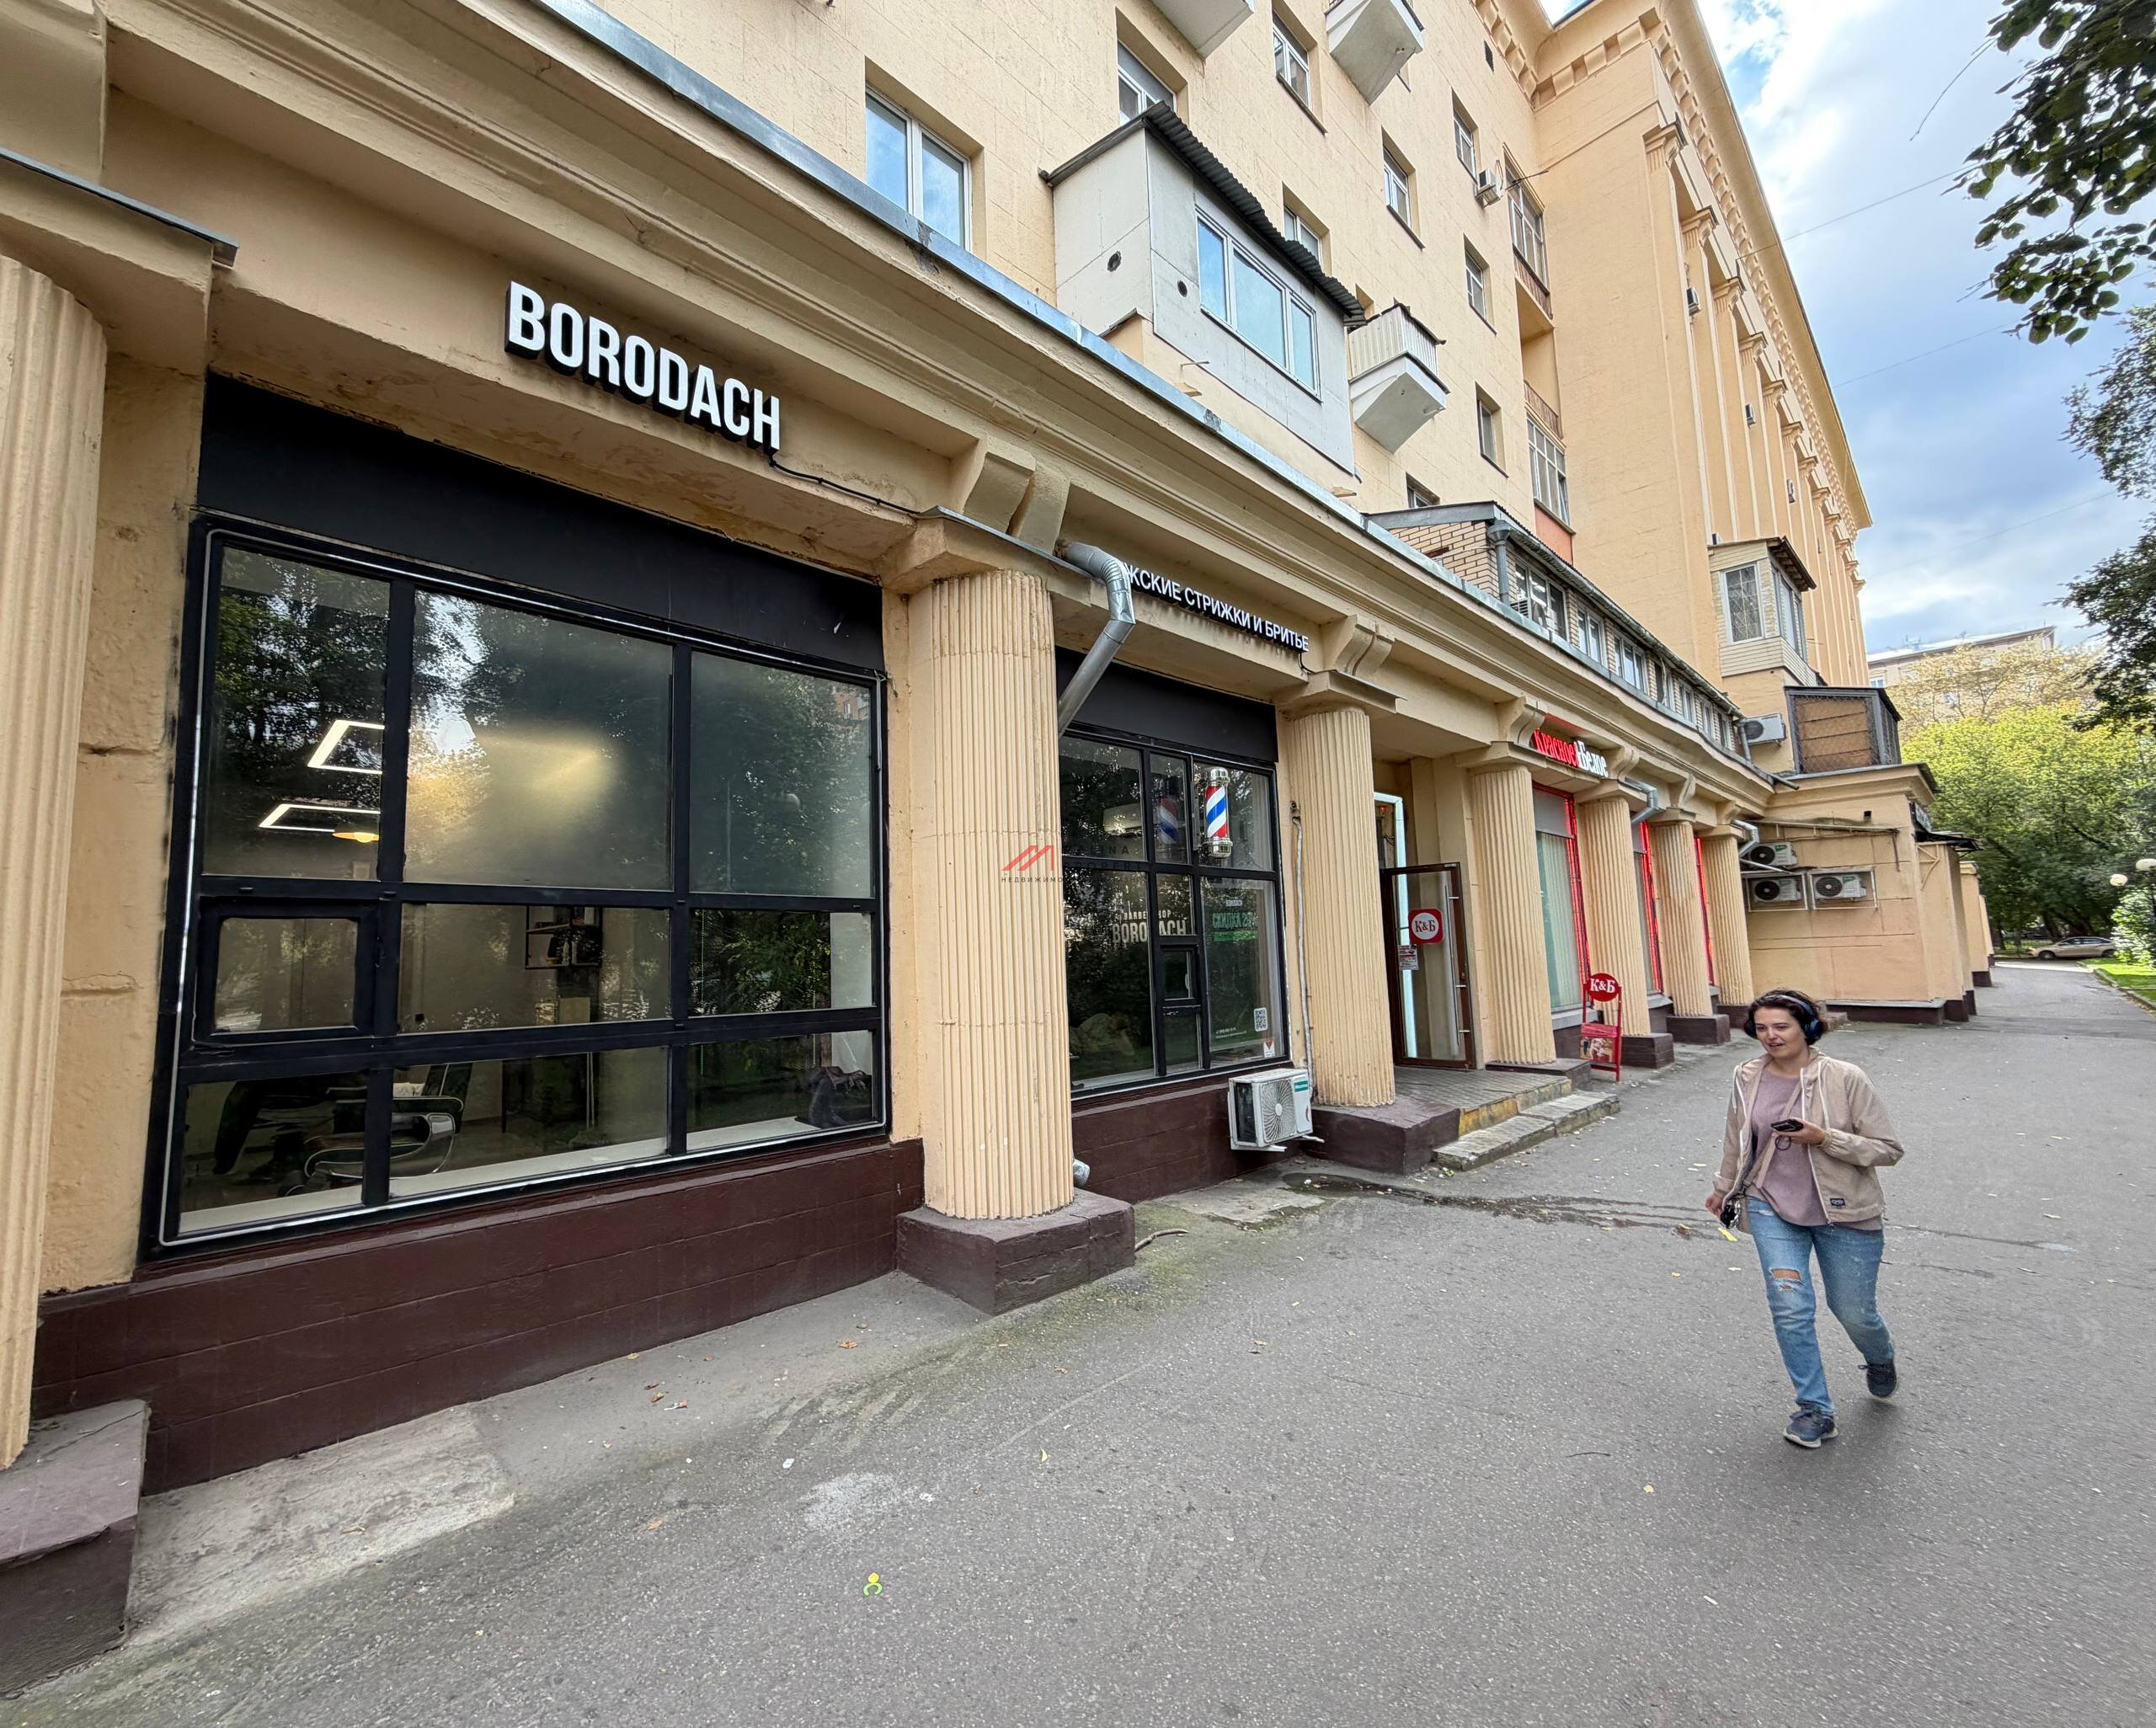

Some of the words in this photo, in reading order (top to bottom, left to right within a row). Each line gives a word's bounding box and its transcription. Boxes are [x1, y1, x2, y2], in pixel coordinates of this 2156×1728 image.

[508, 280, 781, 451] BORODACH
[1123, 562, 1182, 601] ЖСКИЕ
[1184, 587, 1251, 629] СТРИЖКИ
[1253, 615, 1262, 633] И
[1265, 621, 1309, 652] БРИТЬЕ
[1113, 920, 1186, 943] BOROACH
[1414, 920, 1436, 933] К&Б
[1589, 978, 1616, 994] К&Б
